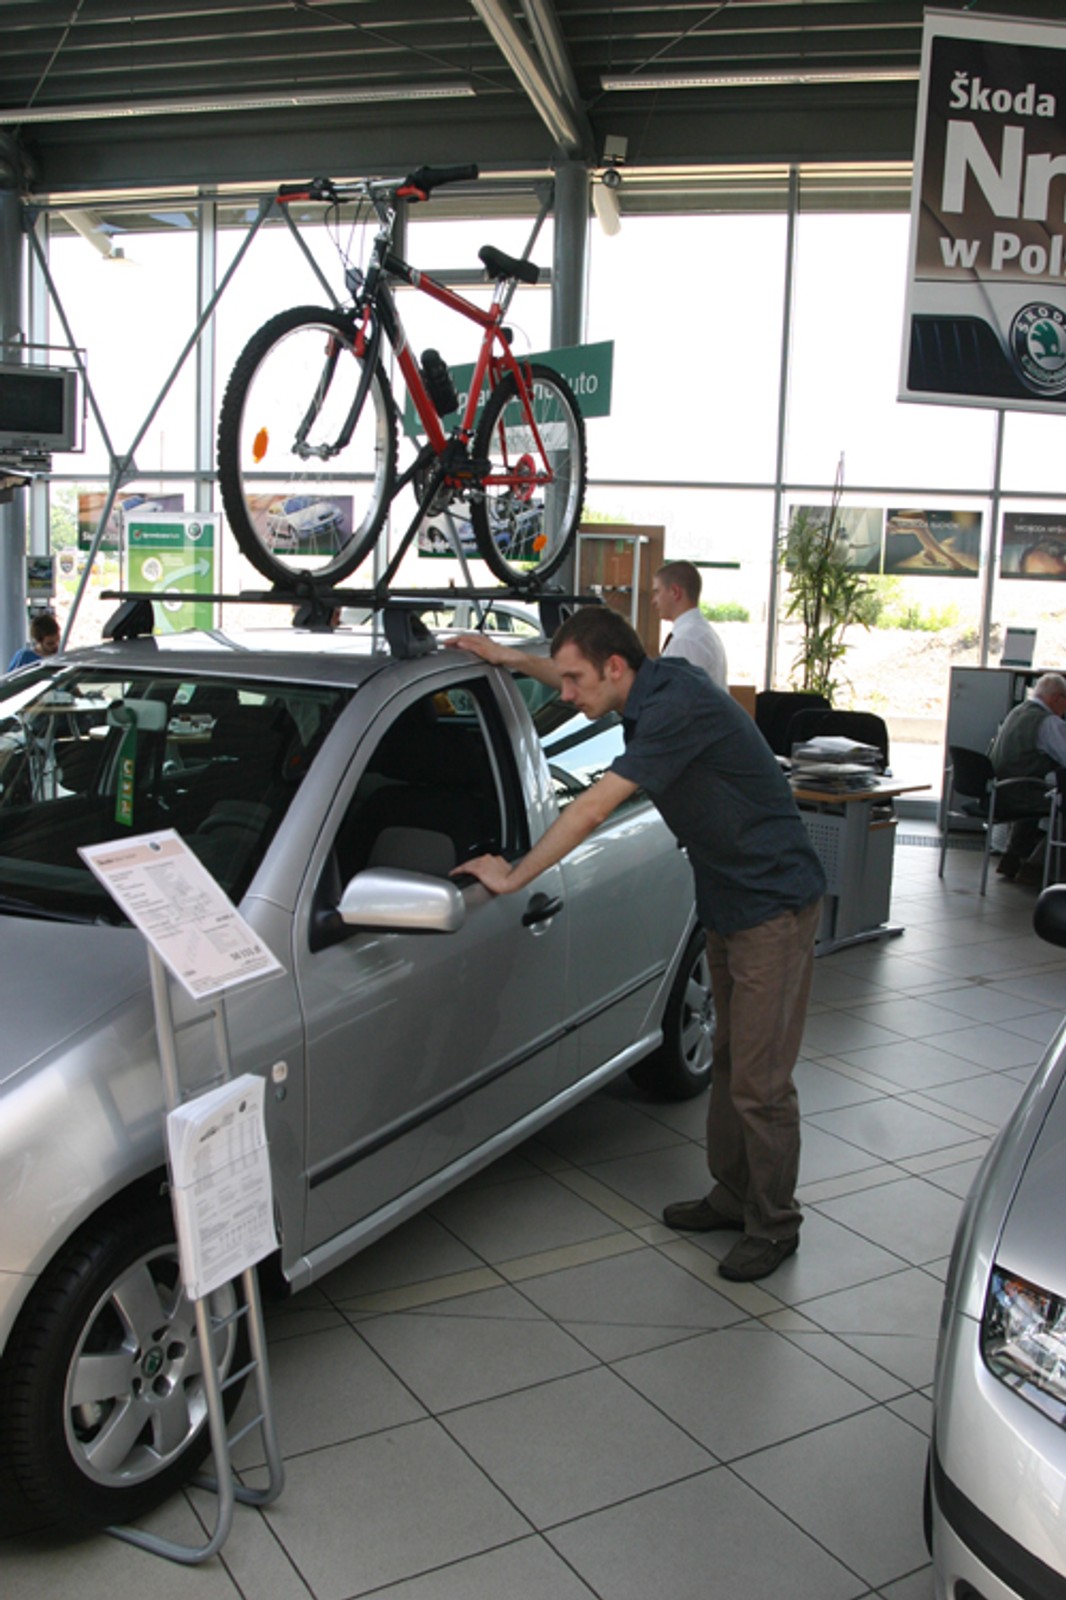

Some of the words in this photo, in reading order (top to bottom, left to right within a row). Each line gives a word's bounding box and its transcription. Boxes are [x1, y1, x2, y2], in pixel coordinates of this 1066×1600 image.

[949, 71, 1056, 117] Škoda
[939, 236, 981, 268] w
[991, 231, 1066, 276] Pol
[561, 371, 598, 396] uto
